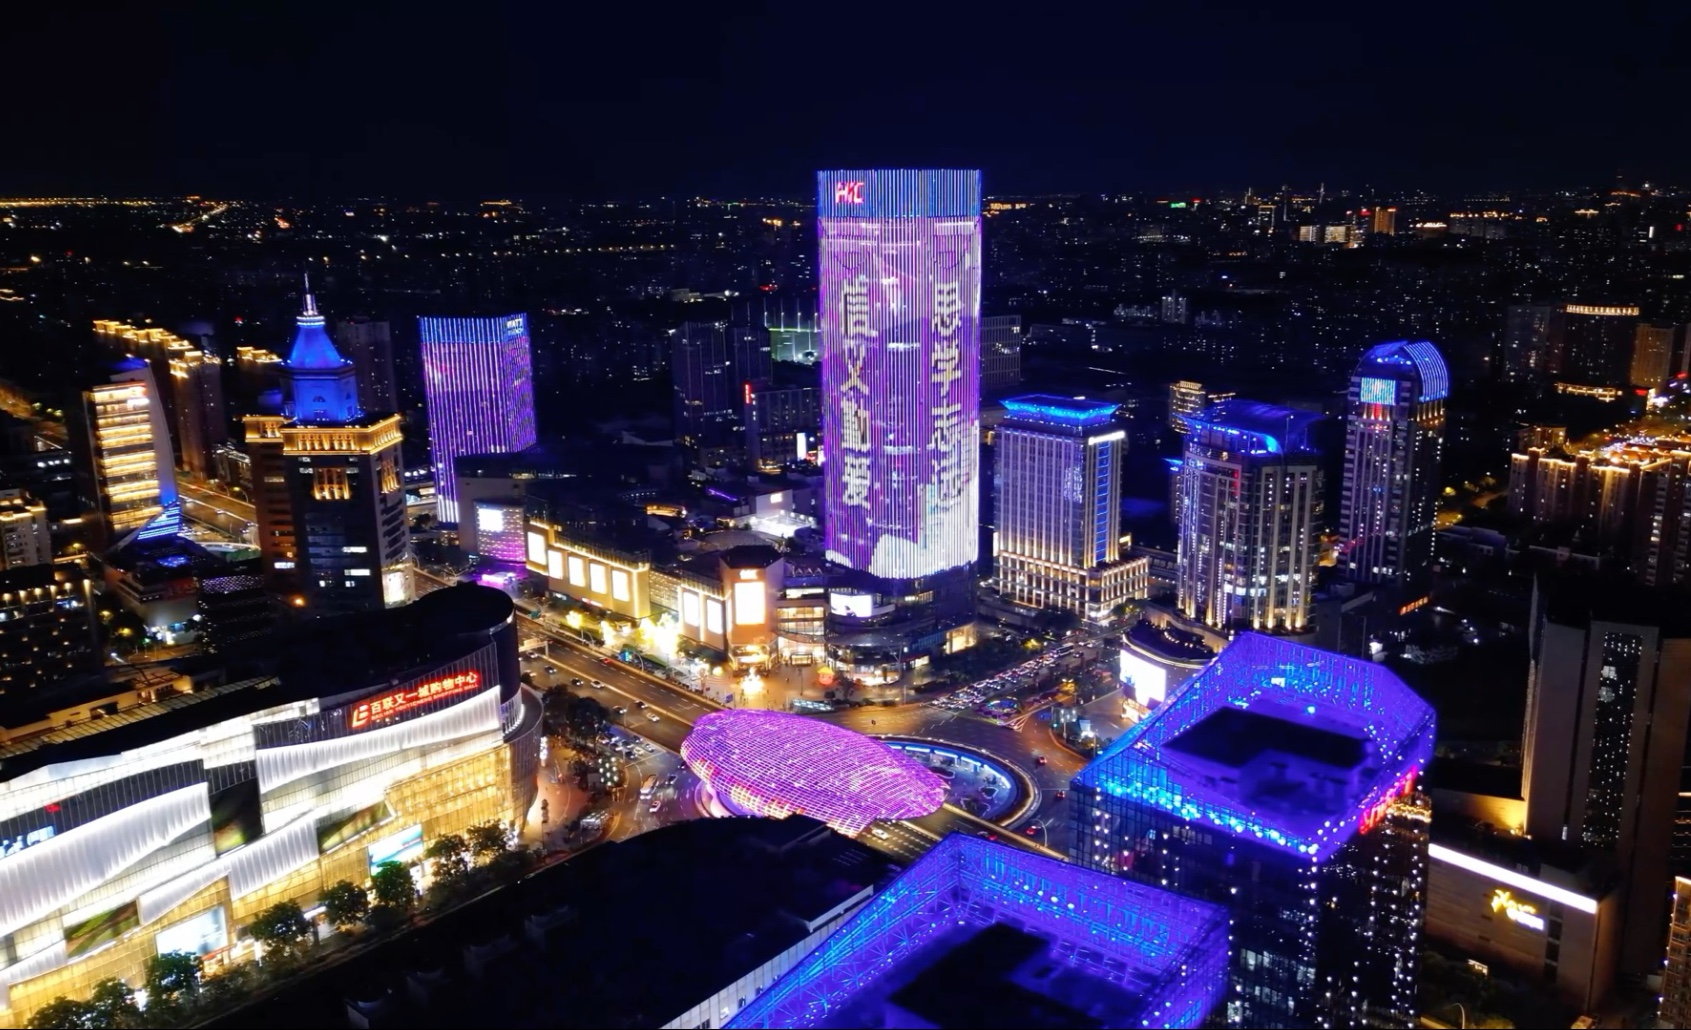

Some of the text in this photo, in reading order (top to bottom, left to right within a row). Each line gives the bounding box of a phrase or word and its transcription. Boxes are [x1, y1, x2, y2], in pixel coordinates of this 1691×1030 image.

[836, 182, 864, 203] HKC
[370, 672, 477, 713] 百联又一城购物中心
